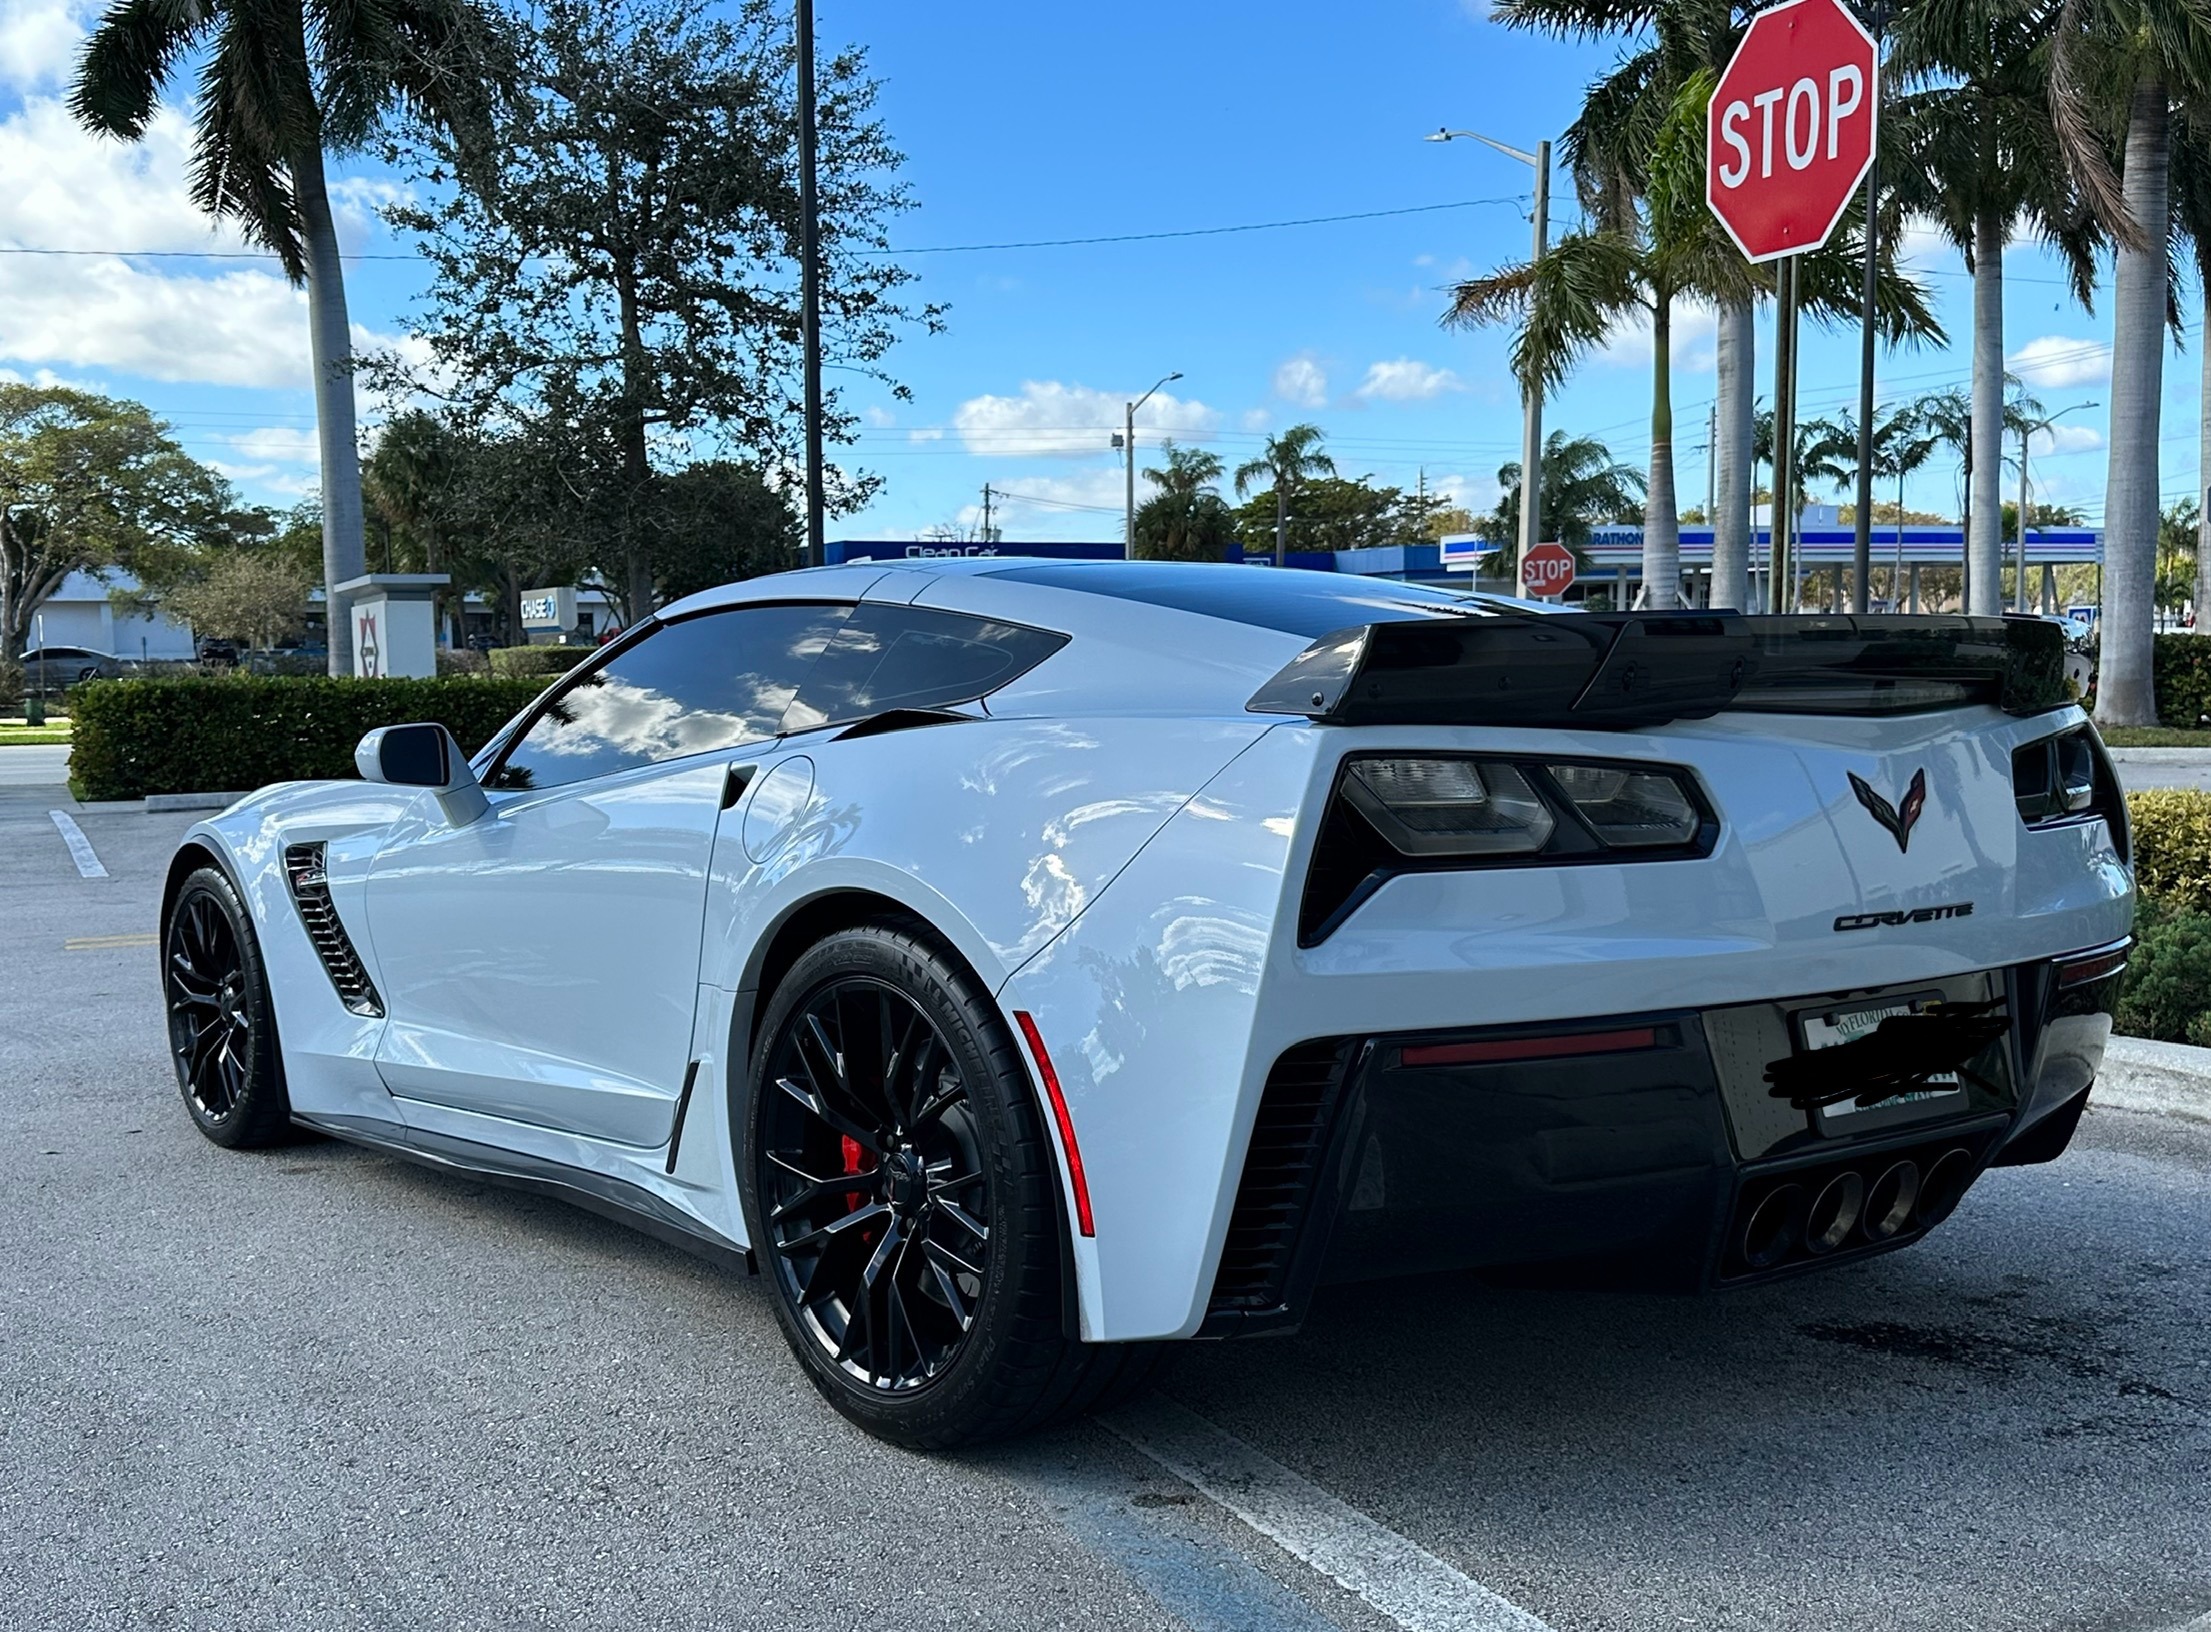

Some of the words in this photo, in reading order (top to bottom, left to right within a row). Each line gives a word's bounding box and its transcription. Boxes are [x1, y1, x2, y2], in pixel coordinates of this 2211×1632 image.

[1719, 64, 1863, 189] STOP
[1590, 532, 1644, 545] RATHON
[905, 545, 961, 558] Clean
[1524, 560, 1571, 580] STOP
[521, 598, 547, 619] CHASE
[1833, 902, 1974, 931] CORVETTE
[939, 1000, 998, 1113] MICHELIN
